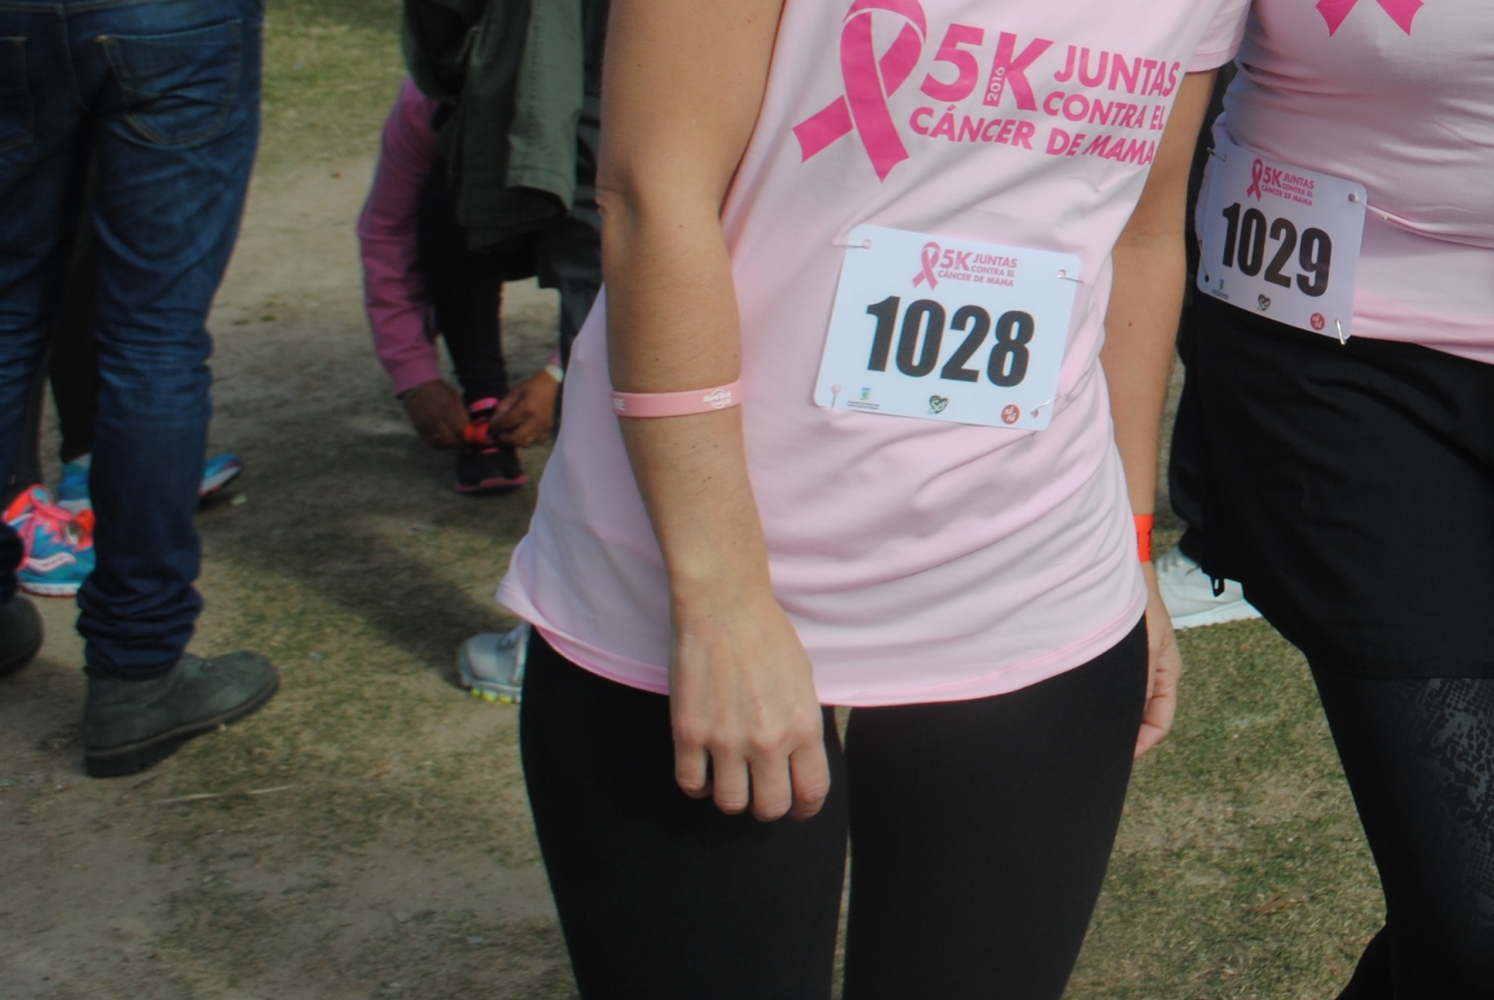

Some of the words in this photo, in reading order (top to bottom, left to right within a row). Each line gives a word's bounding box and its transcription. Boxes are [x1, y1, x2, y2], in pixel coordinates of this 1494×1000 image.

[920, 23, 1054, 111] 5K
[1053, 45, 1180, 97] JUNTAS
[987, 66, 1005, 101] 2016
[1043, 91, 1148, 129] CONTRA
[1150, 105, 1167, 130] EL
[909, 104, 1035, 150] CÁNCER
[1046, 128, 1085, 156] DE
[1082, 135, 1155, 166] MAMA
[1263, 166, 1283, 188] 5K
[1283, 173, 1314, 190] JUNTAS
[1282, 183, 1305, 195] CONTRA
[1293, 195, 1313, 206] MAMA
[940, 249, 973, 271] 5K
[973, 253, 1018, 268] JUNTAS
[1222, 202, 1333, 298] 1029
[938, 269, 972, 282] CÁNCER
[973, 275, 983, 283] DE
[986, 277, 1014, 287] MAMA
[971, 265, 1004, 276] CONTRA
[1007, 270, 1015, 278] EL
[866, 295, 1035, 388] 1028
